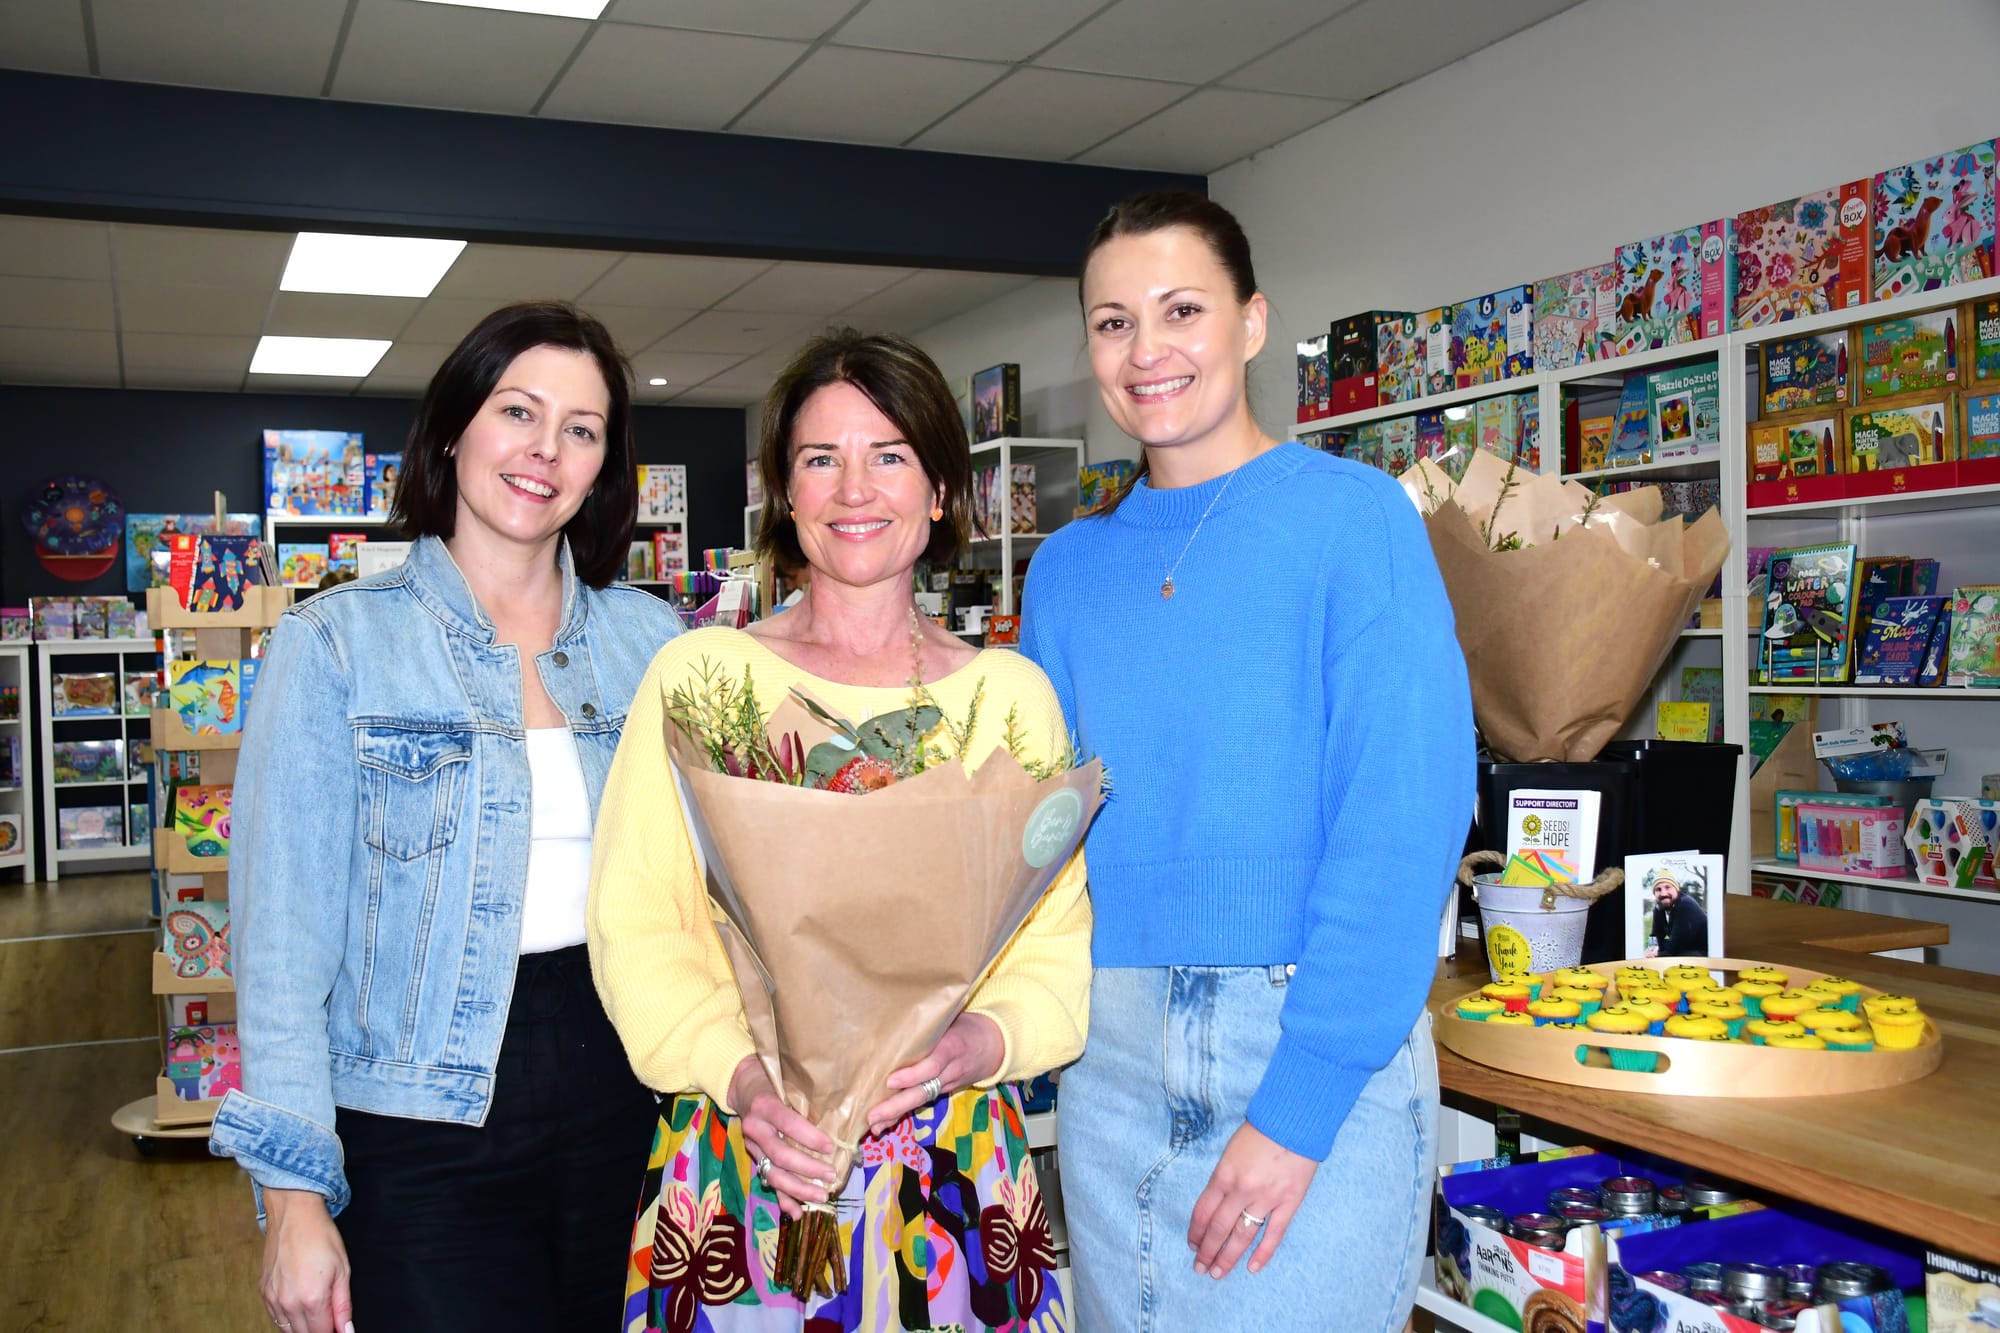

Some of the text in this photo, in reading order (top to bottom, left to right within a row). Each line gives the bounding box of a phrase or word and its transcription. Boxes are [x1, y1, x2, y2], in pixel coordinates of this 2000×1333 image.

[1843, 210, 1863, 224] BOX
[1704, 247, 1721, 259] BOX
[1482, 297, 1492, 315] 6
[1405, 318, 1413, 334] 6
[1979, 317, 2000, 329] MAG
[1769, 356, 1791, 367] MAGIC
[1770, 369, 1791, 378] WORLD
[1655, 380, 1682, 395] Razzle
[1683, 374, 1712, 389] Dazzle
[1972, 413, 1999, 424] MAGIC
[1855, 429, 1879, 440] MAGIC
[1973, 425, 1999, 435] WORLD
[1756, 443, 1778, 453] MAGIC
[1855, 441, 1879, 451] WORLD
[1787, 576, 1829, 593] WATER
[1880, 621, 1928, 641] Magic
[1885, 652, 1911, 662] CARDS
[1515, 800, 1577, 809] SUPPORT DIRECTORY
[1543, 820, 1567, 832] SEEDS
[1543, 832, 1569, 847] HOPE
[1928, 843, 1942, 853] art
[1499, 957, 1515, 970] You
[1926, 1250, 2000, 1284] THINKING PU
[1477, 1261, 1516, 1286] THINKING PUTTY
